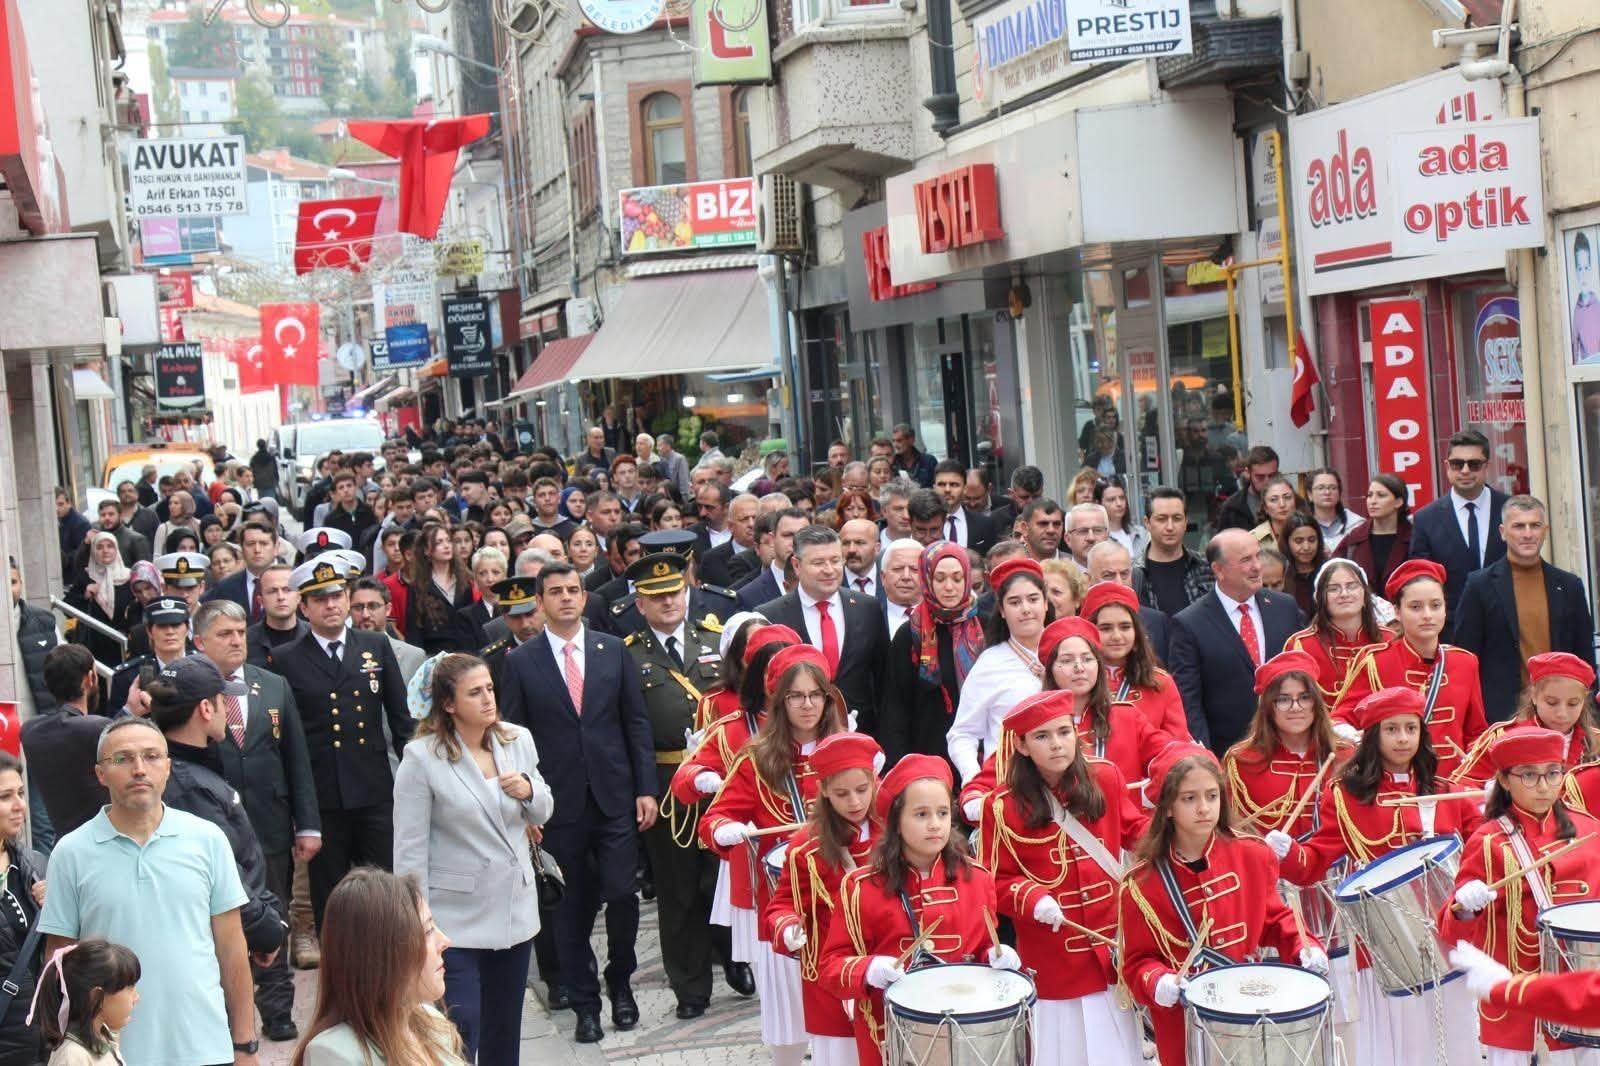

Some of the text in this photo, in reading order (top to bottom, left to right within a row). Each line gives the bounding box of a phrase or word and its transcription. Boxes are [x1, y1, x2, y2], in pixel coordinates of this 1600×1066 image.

[134, 142, 239, 170] AVUKAT
[1307, 128, 1378, 226] ada
[1419, 133, 1509, 176] ada
[138, 201, 244, 215] 0546 513 75 78
[146, 189, 166, 201] Arif
[169, 188, 200, 200] Erkan
[913, 164, 1004, 254] VESTEL
[1404, 186, 1530, 242] optik
[1381, 313, 1419, 399] ADA
